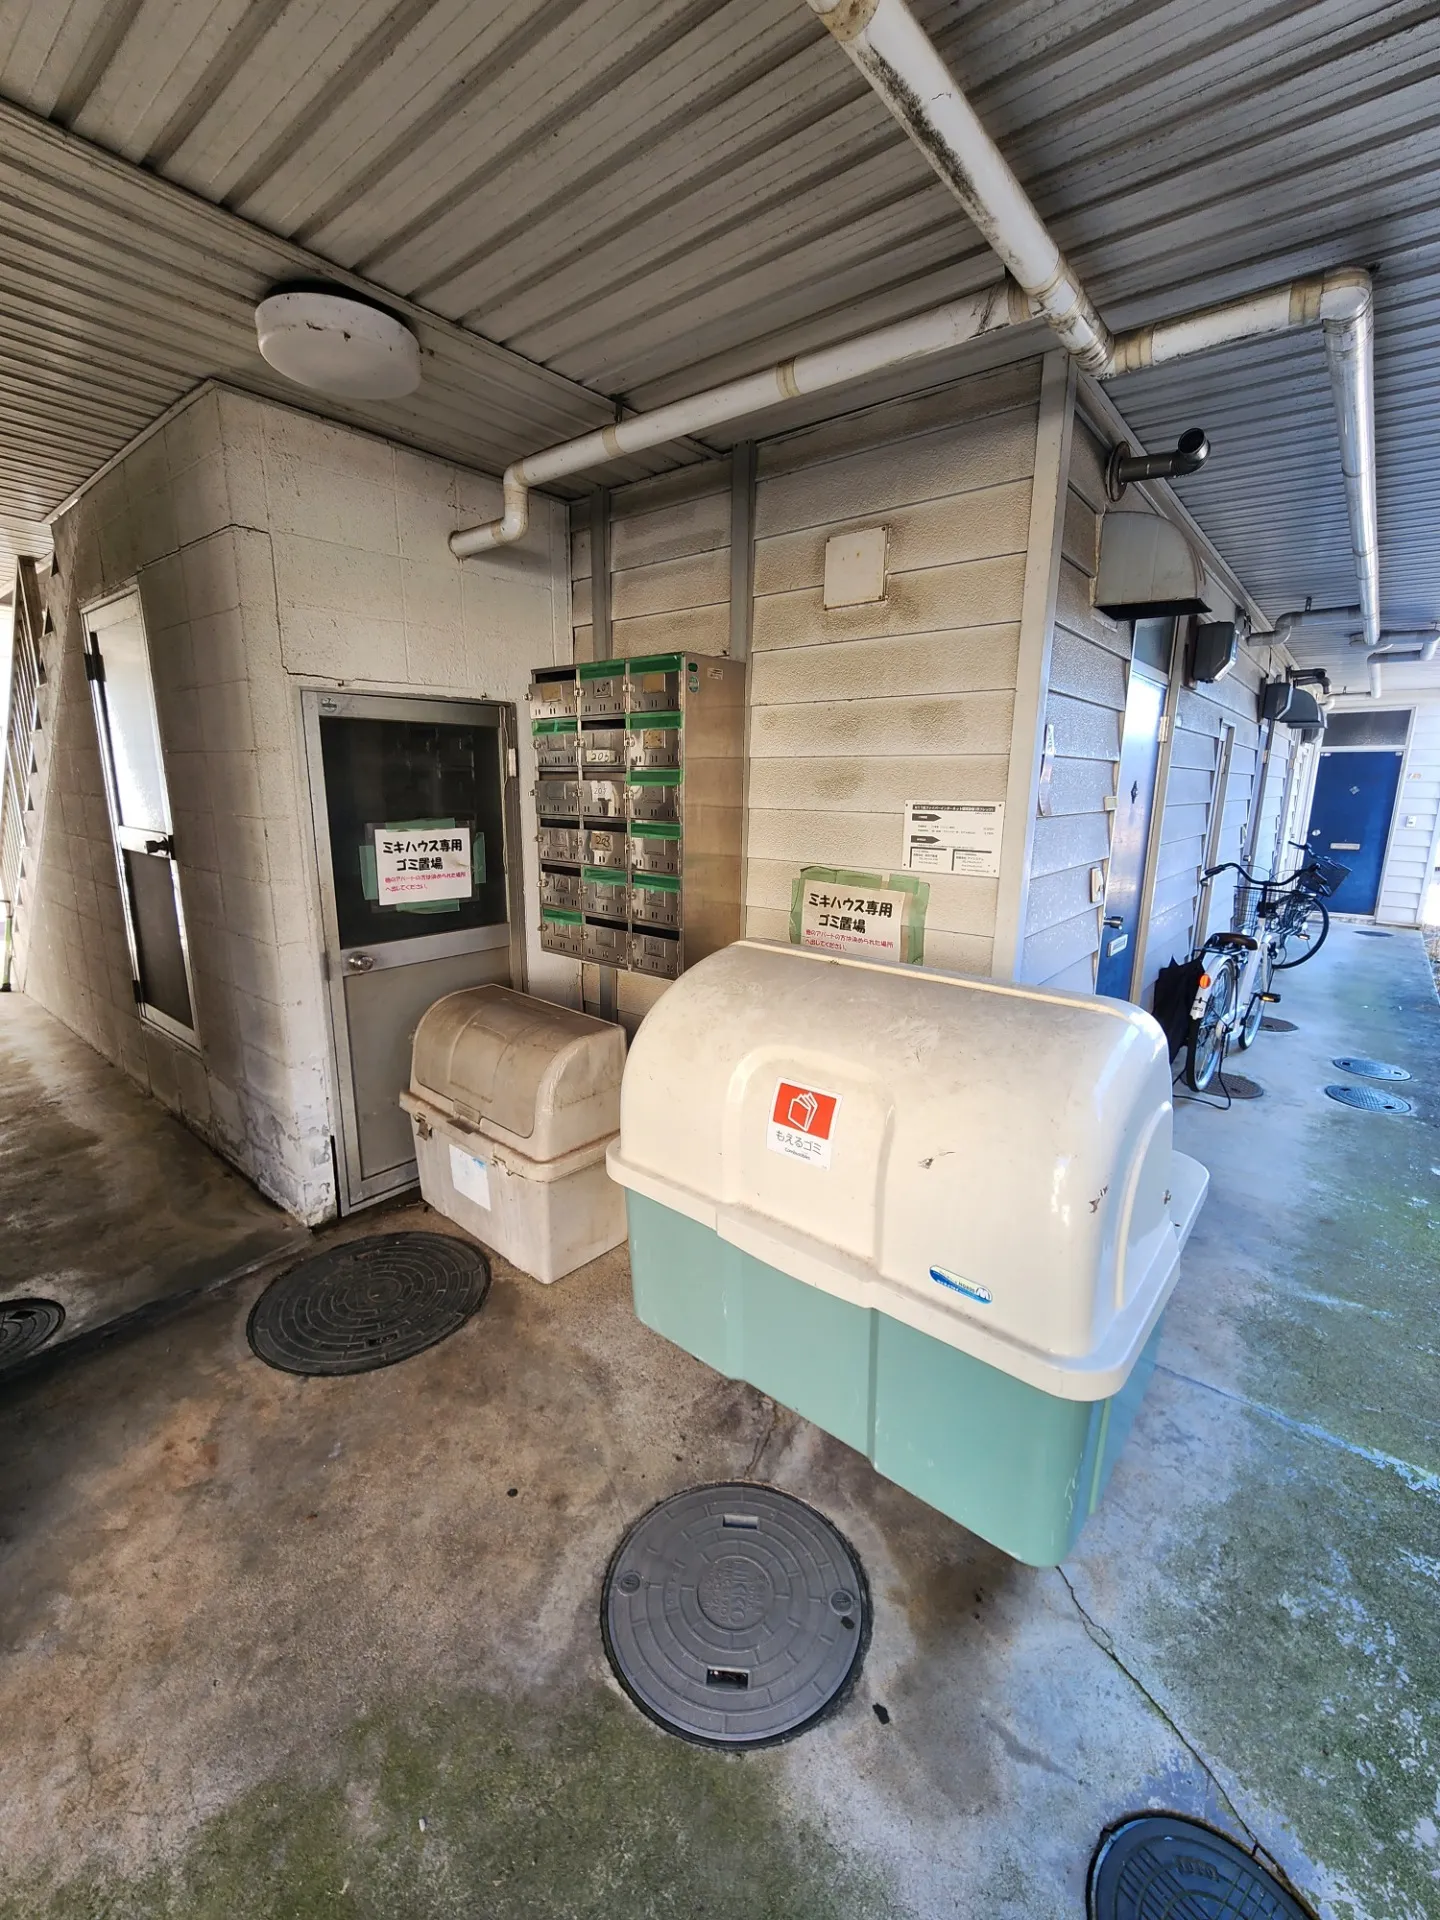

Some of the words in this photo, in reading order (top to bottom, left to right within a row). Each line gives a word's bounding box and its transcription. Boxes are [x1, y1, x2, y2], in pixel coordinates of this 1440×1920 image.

[382, 838, 463, 854] ミキハウス専用
[396, 856, 443, 872] ゴミ置場
[808, 892, 893, 918] ミキハウス専用
[818, 914, 866, 934] ゴミ置場
[776, 1130, 822, 1156] もえるゴミ
